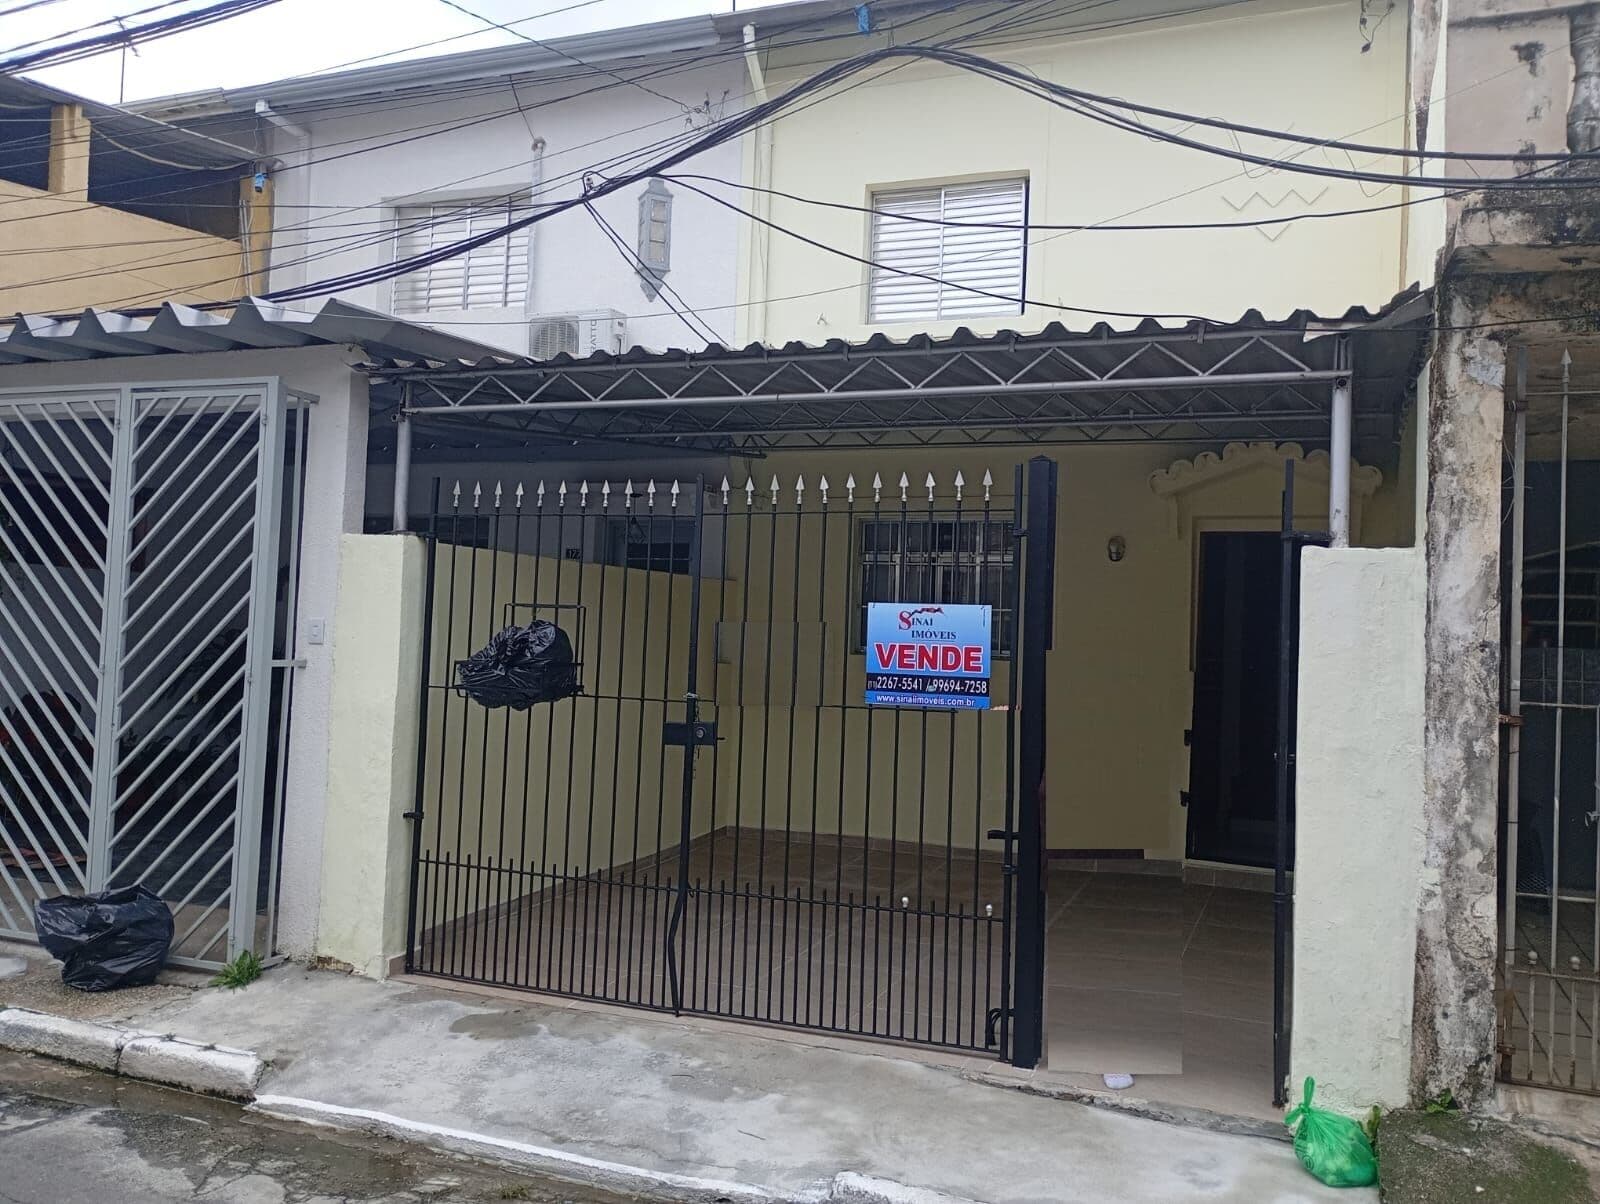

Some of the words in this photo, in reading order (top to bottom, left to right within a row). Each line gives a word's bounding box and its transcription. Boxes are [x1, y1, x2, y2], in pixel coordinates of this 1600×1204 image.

[911, 628, 957, 640] IMÓVEIS
[875, 643, 983, 673] VENDE
[876, 695, 975, 707] www.sinaiimoveis.com.br
